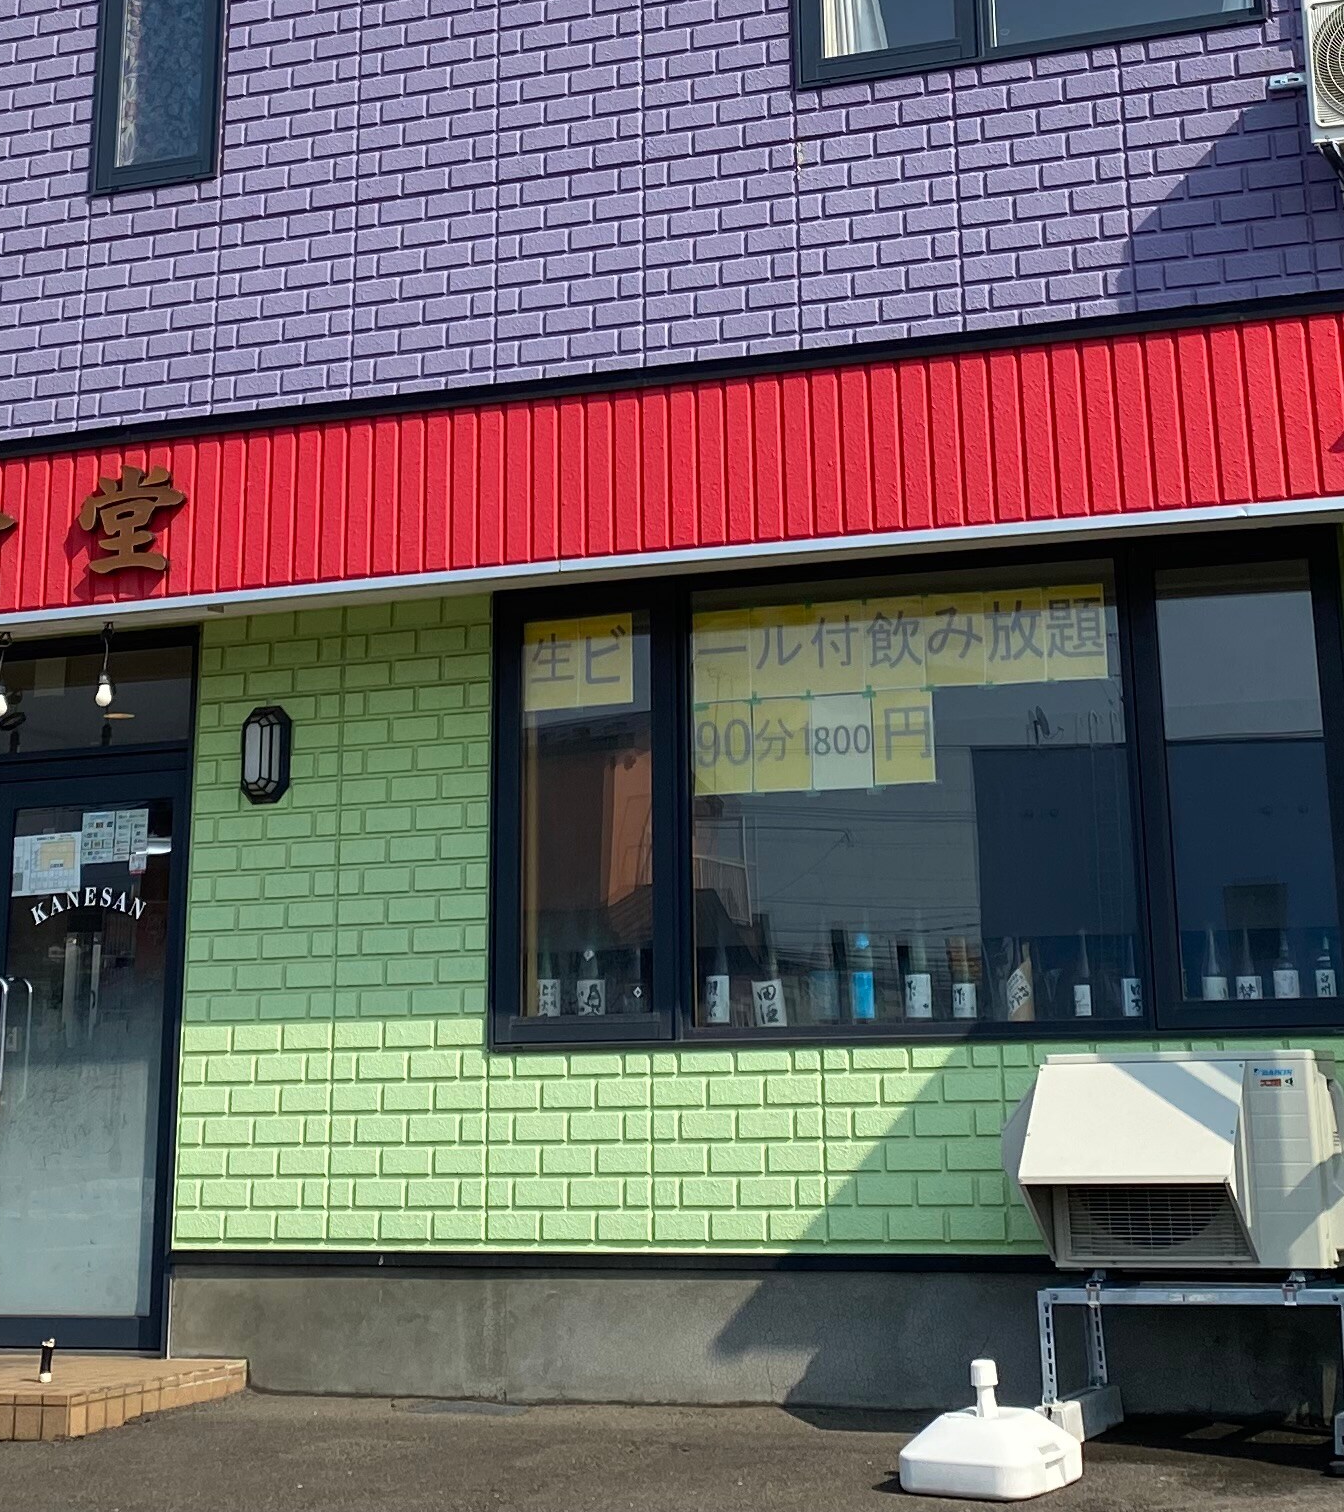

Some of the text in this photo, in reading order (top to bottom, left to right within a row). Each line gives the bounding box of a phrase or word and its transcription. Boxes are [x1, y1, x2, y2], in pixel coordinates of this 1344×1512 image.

[530, 596, 1106, 687] 生ビ ール付飲み放題
[30, 886, 147, 926] KANESAN
